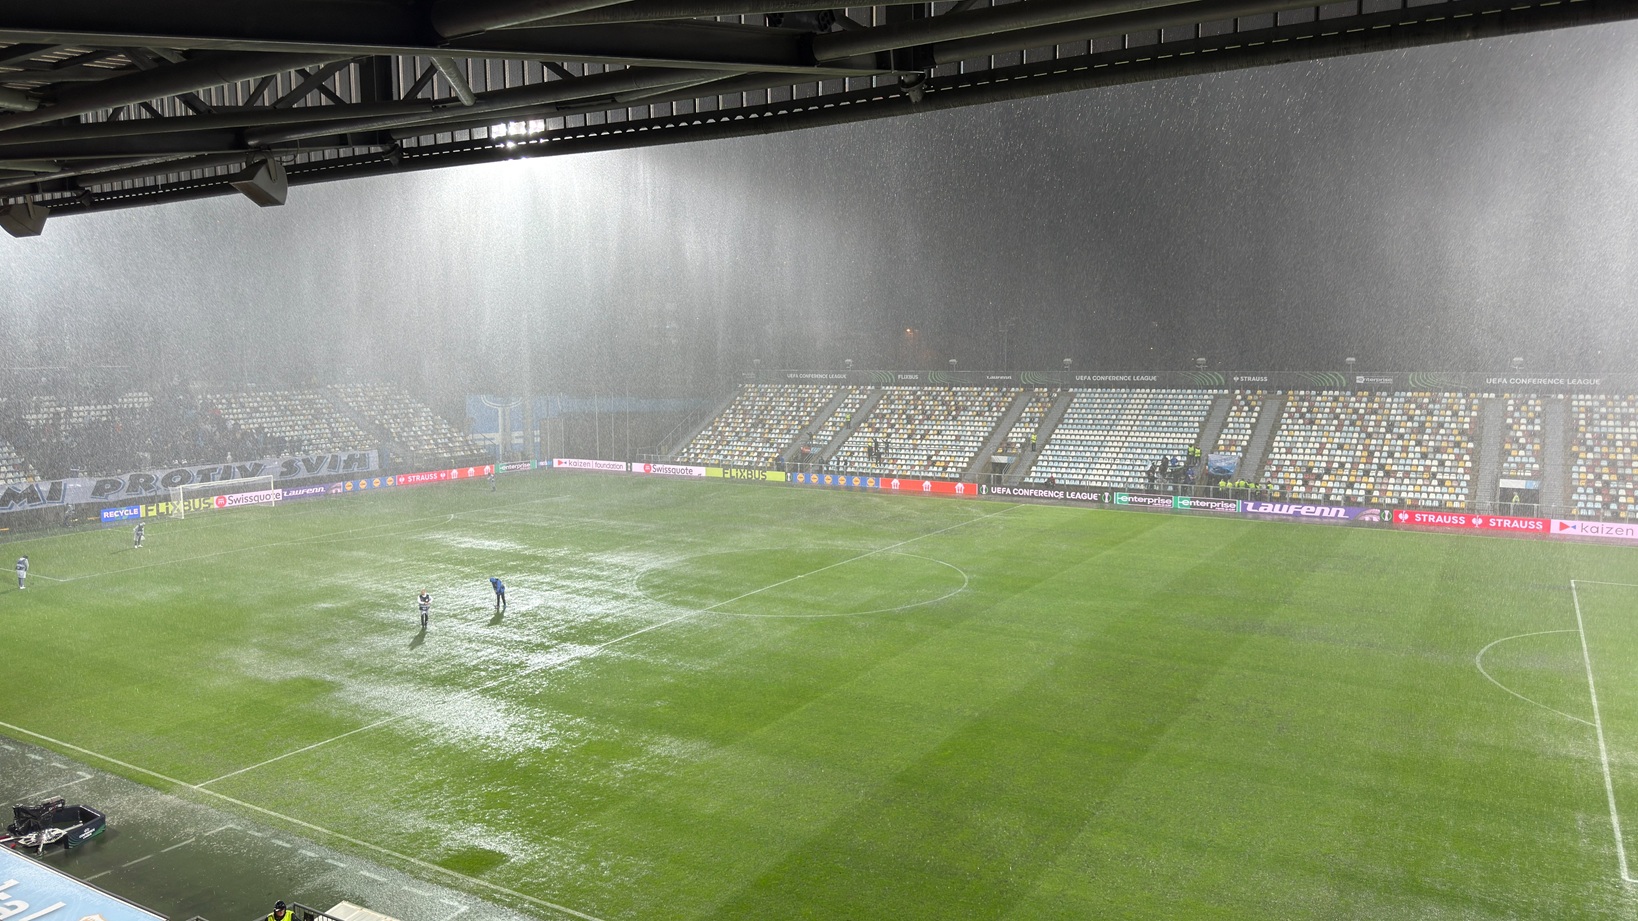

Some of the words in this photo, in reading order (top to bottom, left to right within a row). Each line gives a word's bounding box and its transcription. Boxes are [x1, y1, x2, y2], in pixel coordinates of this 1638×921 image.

[501, 462, 531, 472] enterprise
[568, 459, 591, 468] kaizen
[594, 461, 624, 470] foundation
[652, 464, 693, 475] Swissquote
[91, 462, 266, 499] PROTIV
[280, 452, 369, 478] SVIH
[408, 473, 438, 483] STRAUSS
[228, 491, 281, 505] Swissquote
[991, 487, 1011, 496] UEFA
[1012, 488, 1065, 499] CONFERENCE
[1066, 491, 1099, 501] LEAGUE
[1120, 495, 1172, 505] enterprise
[1181, 499, 1237, 509] enterprise
[103, 508, 139, 519] RECYCLE
[1244, 501, 1349, 518] Laufenn
[1415, 513, 1466, 525] STRAUSS
[1489, 518, 1543, 530] STRAUSS
[1580, 523, 1634, 536] kaizen
